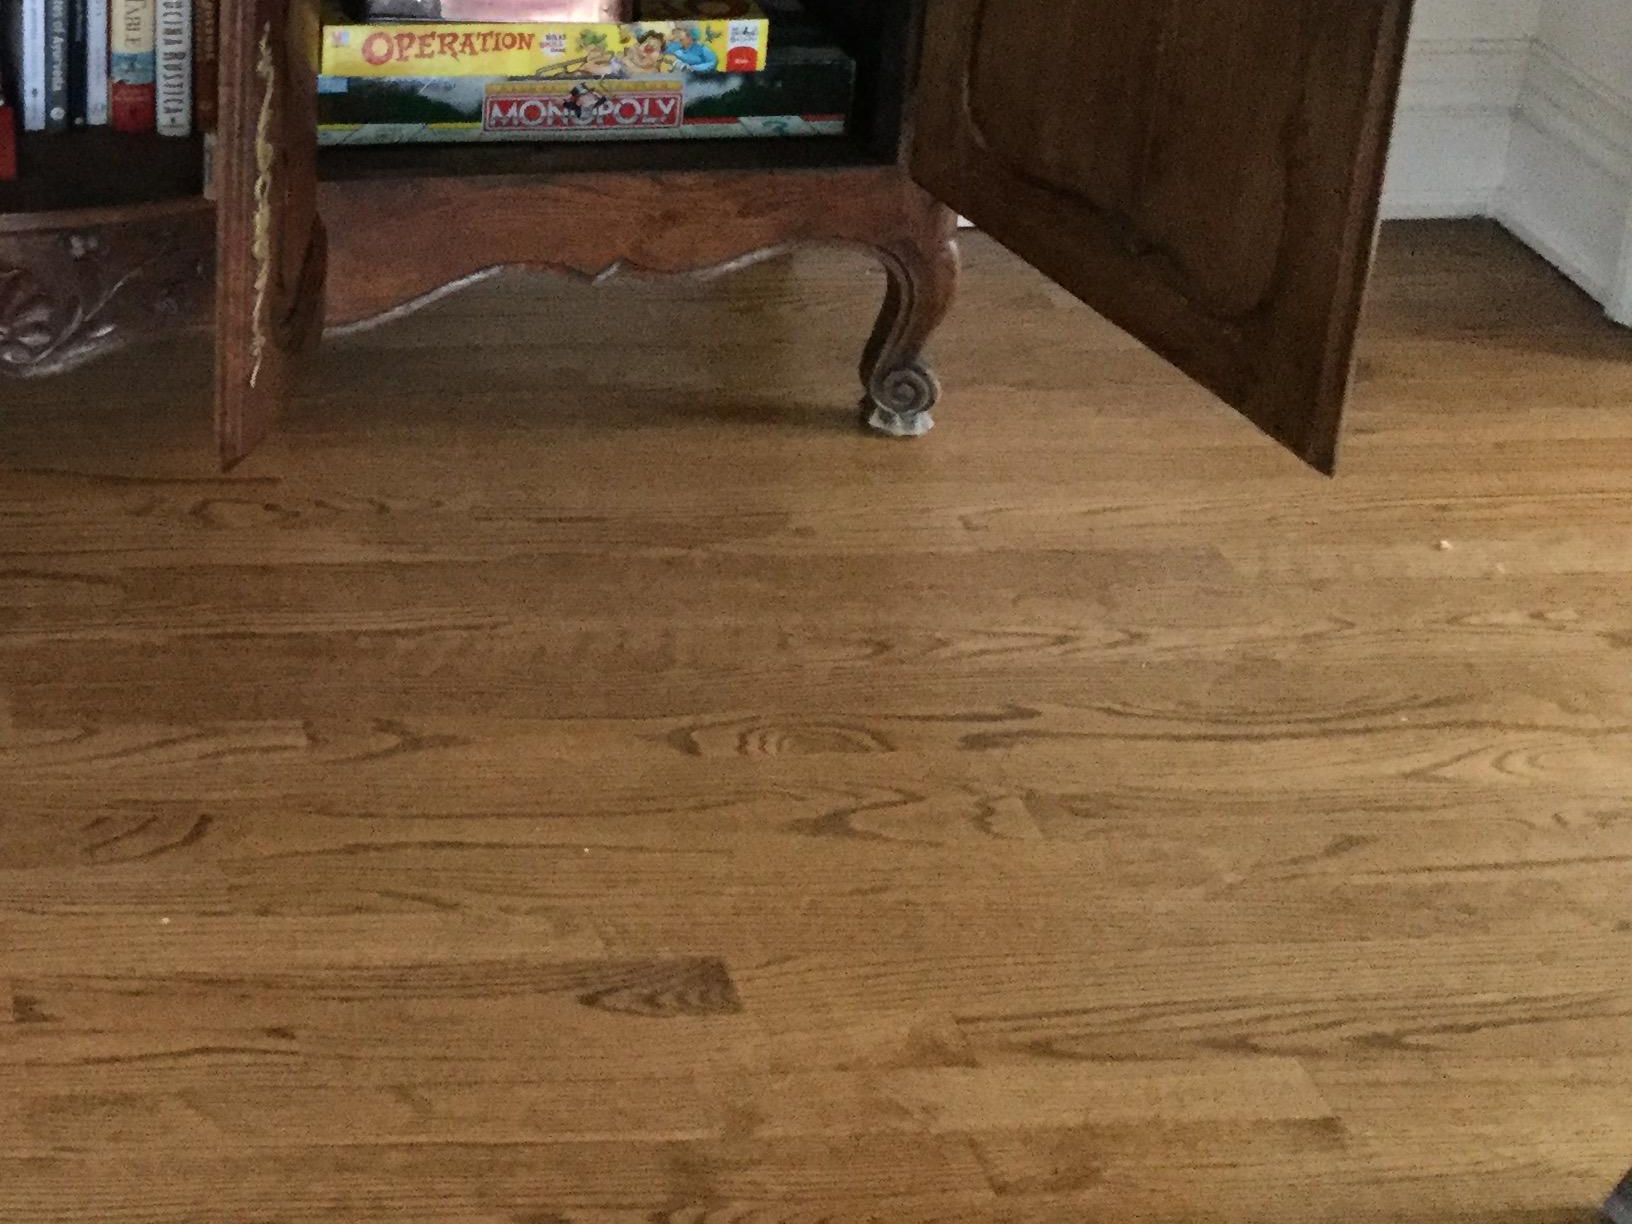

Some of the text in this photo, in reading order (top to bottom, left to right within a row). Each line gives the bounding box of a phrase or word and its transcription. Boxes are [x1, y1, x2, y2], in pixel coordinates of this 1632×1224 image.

[52, 21, 65, 33] of
[50, 36, 65, 92] Ayurveda
[361, 30, 536, 66] OPERATION
[162, 51, 186, 114] RUSTICA
[490, 97, 675, 126] MONOPOLY
